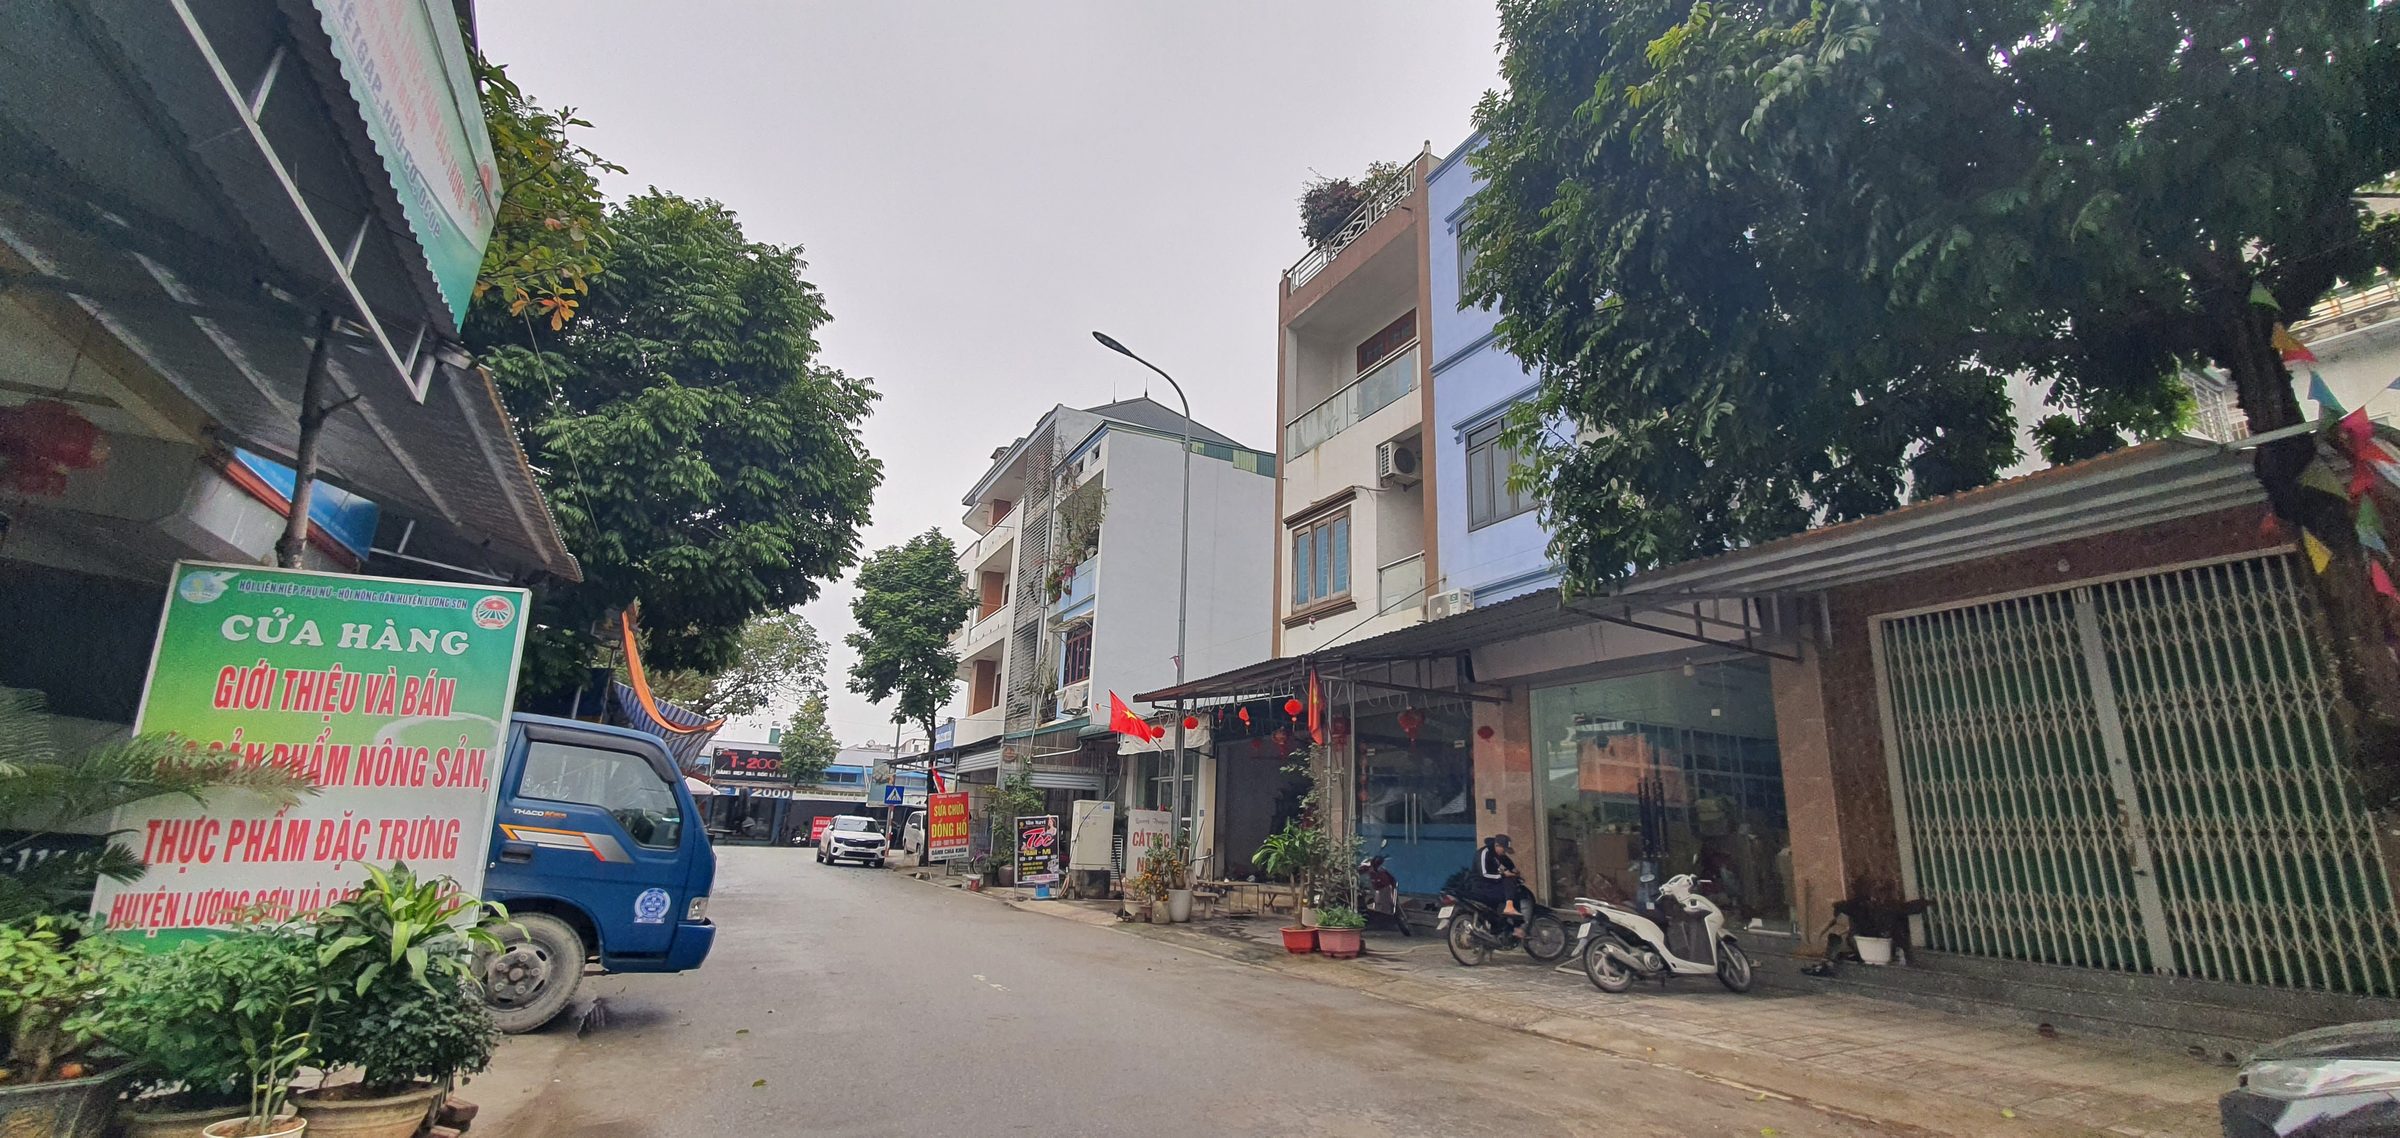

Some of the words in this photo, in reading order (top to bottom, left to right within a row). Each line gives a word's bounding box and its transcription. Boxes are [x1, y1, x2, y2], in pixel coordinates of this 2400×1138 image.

[221, 607, 324, 647] CỬA
[337, 619, 469, 656] HÀNG
[213, 658, 279, 711] GIỚI
[281, 663, 363, 722] THIỆU
[365, 665, 398, 716] VÀ
[400, 668, 456, 717] BÁN
[354, 737, 428, 787] NÔNG
[432, 734, 490, 794] SẢN,
[513, 808, 544, 817] THACO
[750, 788, 790, 799] 2000
[948, 801, 965, 816] CHỮA
[142, 816, 220, 873] THỰC
[222, 803, 311, 863] PHẨM
[313, 809, 371, 871] ĐẶC
[377, 815, 461, 861] TRƯNG
[1132, 828, 1151, 848] CẮT
[106, 885, 175, 936] HUYỆN
[177, 885, 250, 927] LƯƠNG
[297, 881, 322, 922] VÀ
